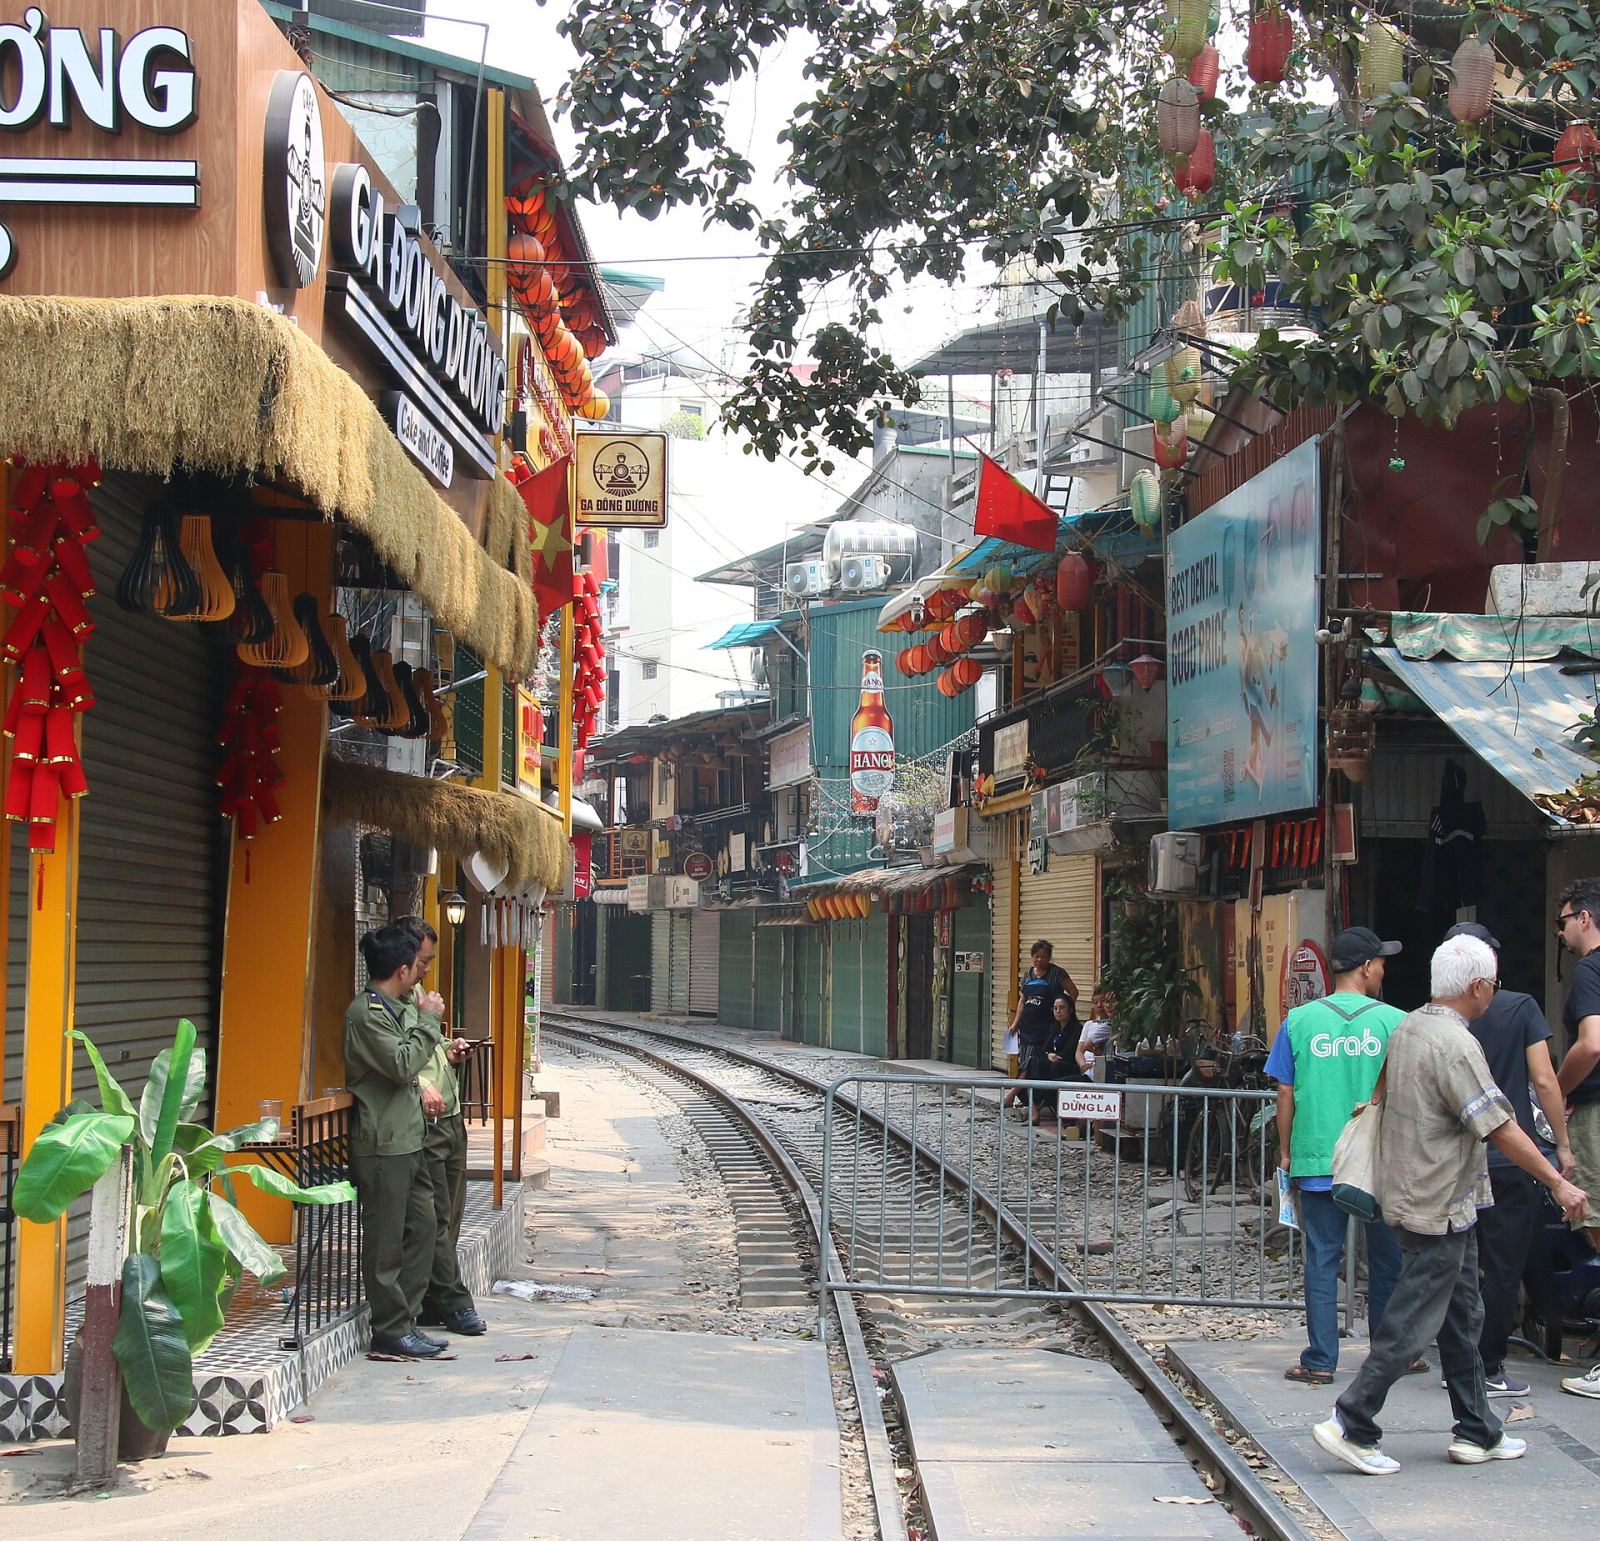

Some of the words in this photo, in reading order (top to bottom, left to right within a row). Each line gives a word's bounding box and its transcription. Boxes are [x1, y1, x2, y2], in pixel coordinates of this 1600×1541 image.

[351, 164, 384, 292] GA
[445, 298, 506, 434] DƯƠNG
[401, 402, 418, 446] Cake
[418, 427, 432, 461] and
[430, 437, 450, 479] Coffee
[580, 500, 594, 512] GA
[596, 497, 623, 512] ĐÔNG
[625, 498, 659, 512] DƯƠNG
[1171, 564, 1192, 616] BEST
[1190, 551, 1219, 604] DENTAL
[1171, 624, 1197, 687] GOOD
[1198, 608, 1228, 675] PRICE
[1310, 1027, 1382, 1058] Grab
